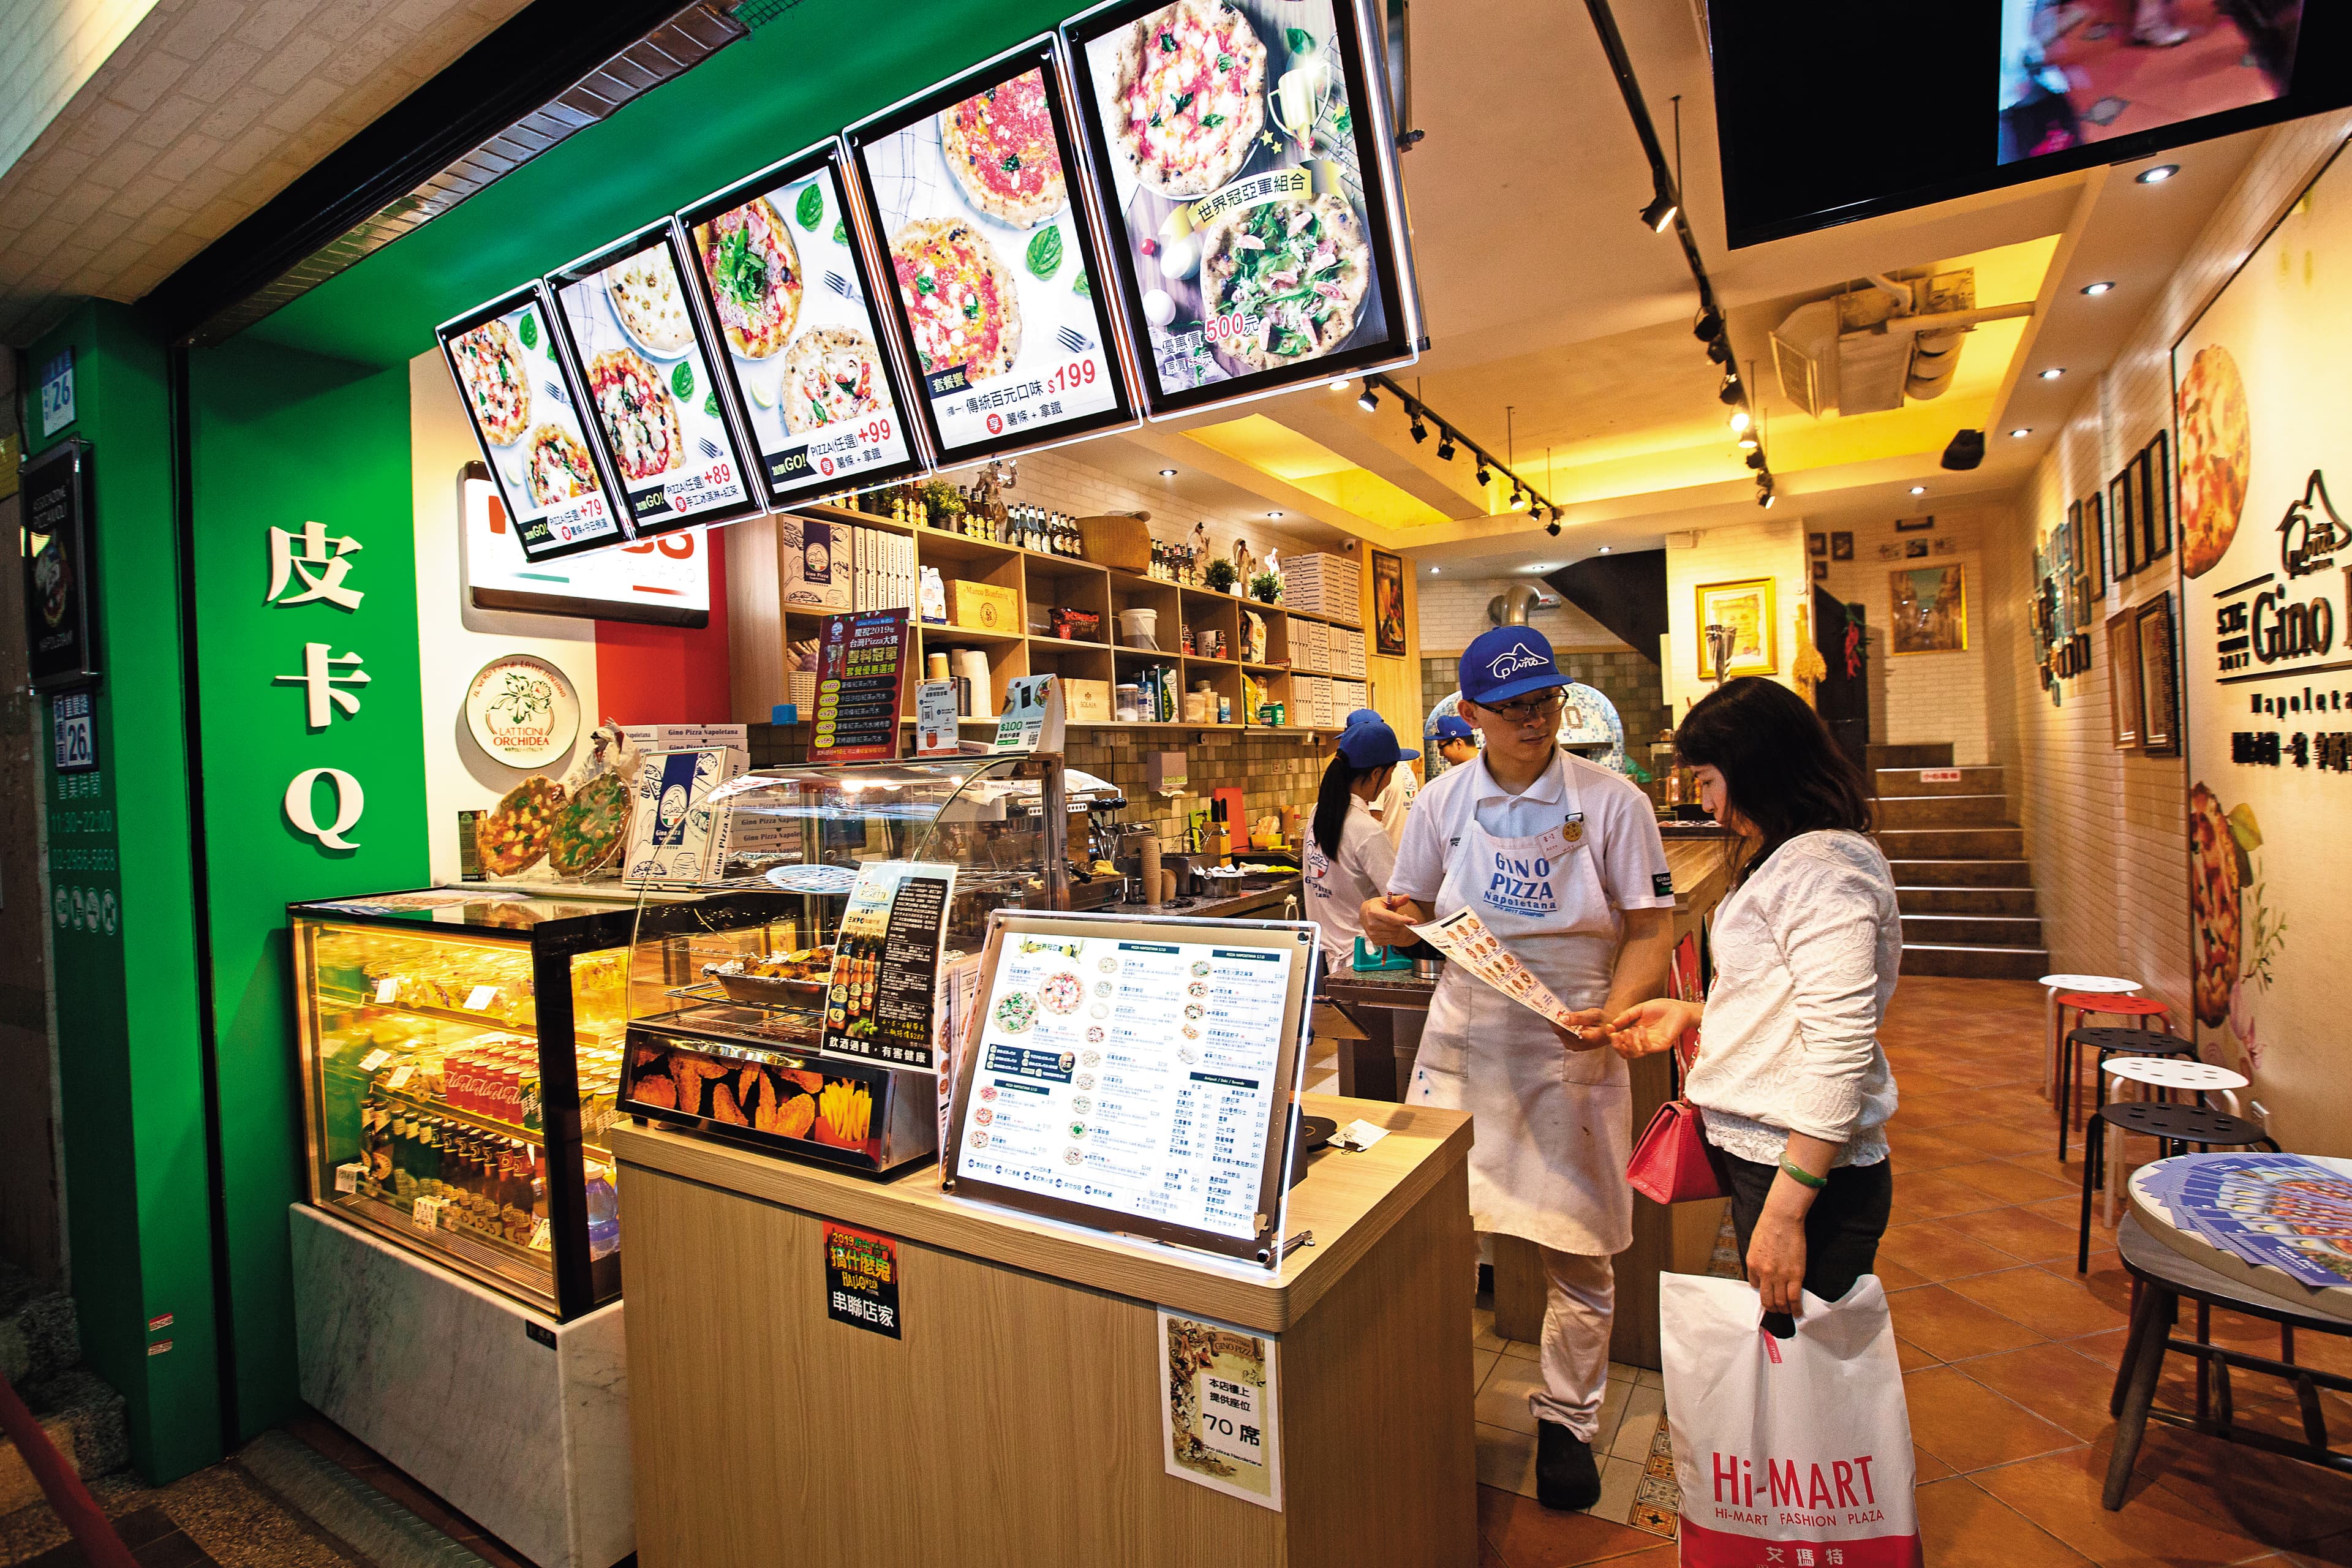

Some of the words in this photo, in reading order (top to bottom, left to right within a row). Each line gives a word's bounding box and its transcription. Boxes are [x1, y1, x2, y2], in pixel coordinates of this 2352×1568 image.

[1197, 171, 1306, 224] 世界冠亞軍組合
[1163, 331, 1202, 356] 優惠價
[1205, 313, 1259, 342] 500元
[51, 374, 71, 412] 26
[966, 380, 1044, 415] 傳統百元口味
[1048, 359, 1096, 394] $199
[858, 418, 891, 443] +99
[704, 463, 730, 484] +89
[581, 499, 602, 517] +79
[2252, 584, 2333, 664] Gino
[1000, 720, 1023, 731] $100
[493, 737, 550, 746] ORCHIDEA
[715, 853, 723, 875] Gino
[1496, 852, 1550, 878] GINO
[1490, 873, 1553, 900] PIZZA
[1484, 891, 1556, 909] Napoletana
[832, 1232, 854, 1246] 2019
[833, 1291, 894, 1327] 串聯店家
[1235, 1344, 1254, 1356] PIZZ
[1208, 1378, 1250, 1398] 本店樓上
[1209, 1392, 1251, 1412] 提供座位
[1202, 1413, 1234, 1436] 70
[1239, 1424, 1260, 1447] 席
[1713, 1452, 1875, 1510] Hi-MART
[1715, 1508, 1768, 1526] Hi-MART
[1780, 1512, 1836, 1527] FASHION
[1848, 1510, 1885, 1525] PLAZA
[1765, 1547, 1844, 1567] 艾瑪特
